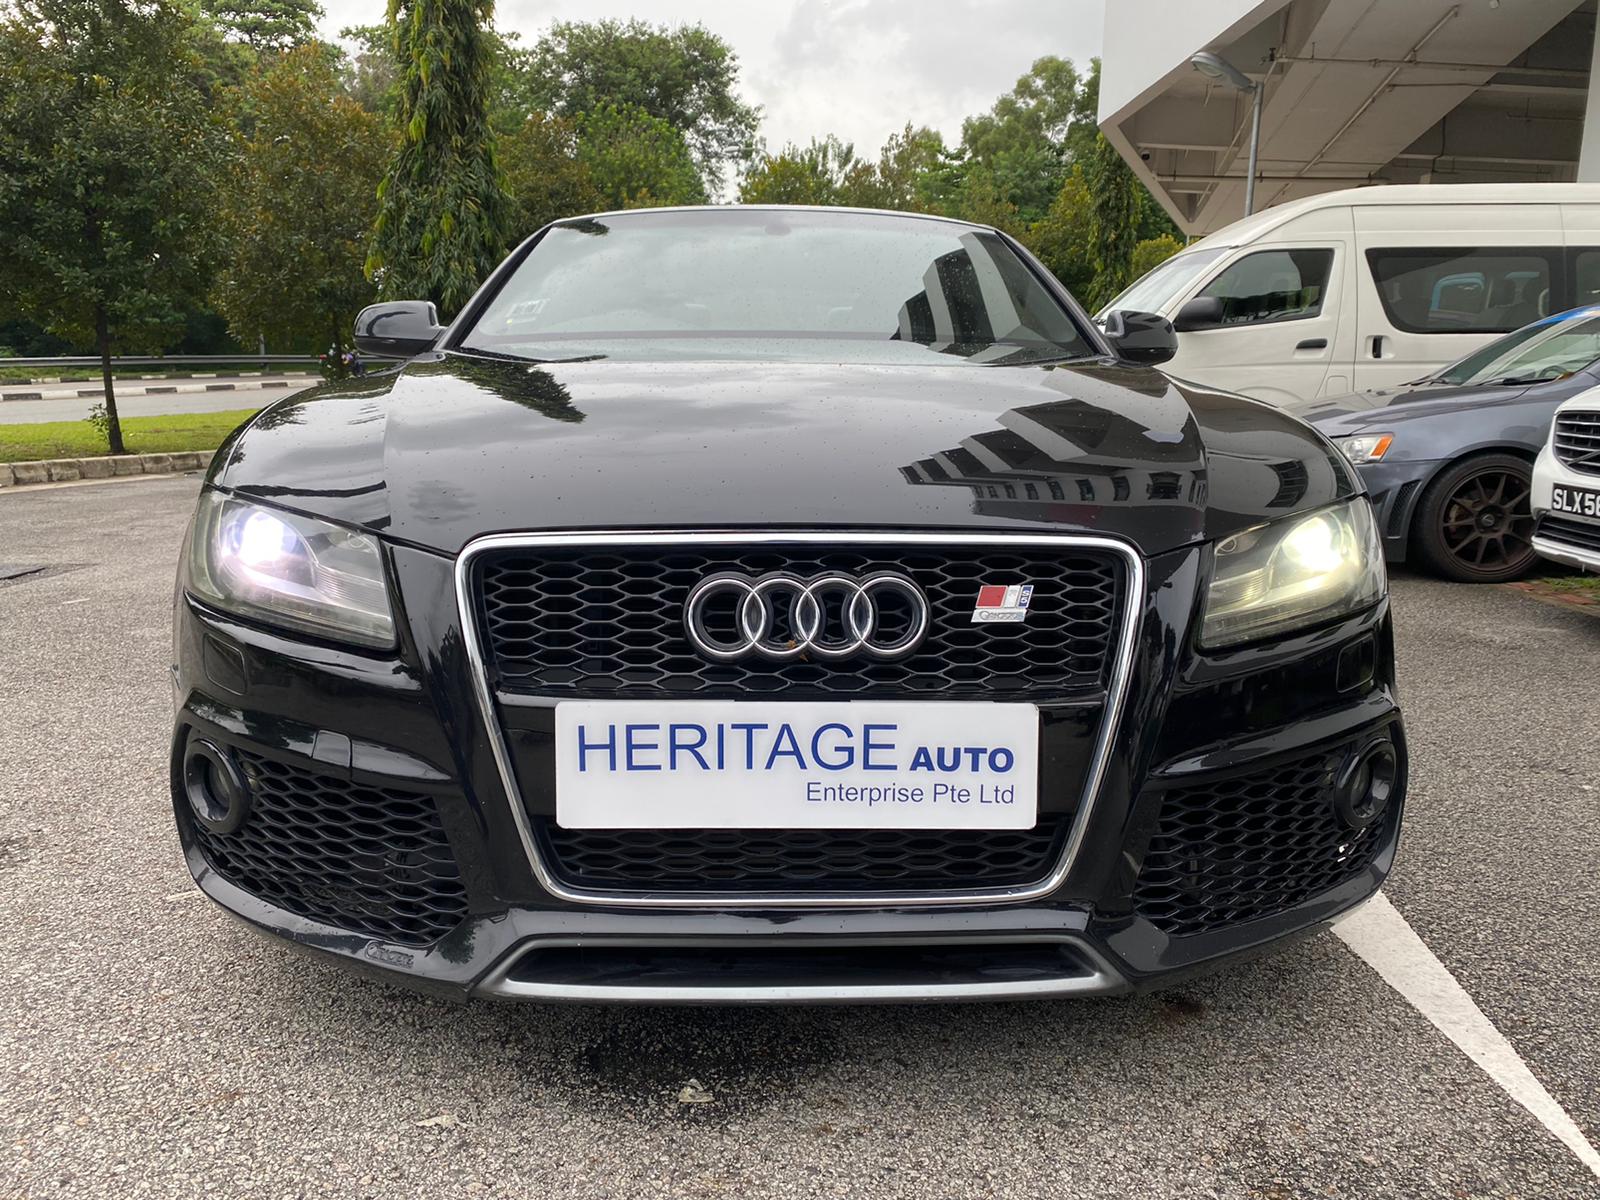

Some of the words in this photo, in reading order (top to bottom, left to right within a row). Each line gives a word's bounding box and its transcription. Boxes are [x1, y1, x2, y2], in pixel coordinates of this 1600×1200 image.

[578, 723, 898, 773] HERITAGE
[910, 746, 1015, 773] AUTO
[806, 782, 924, 806] Enterprise
[933, 783, 971, 803] Pte
[979, 783, 1015, 804] Ltd
